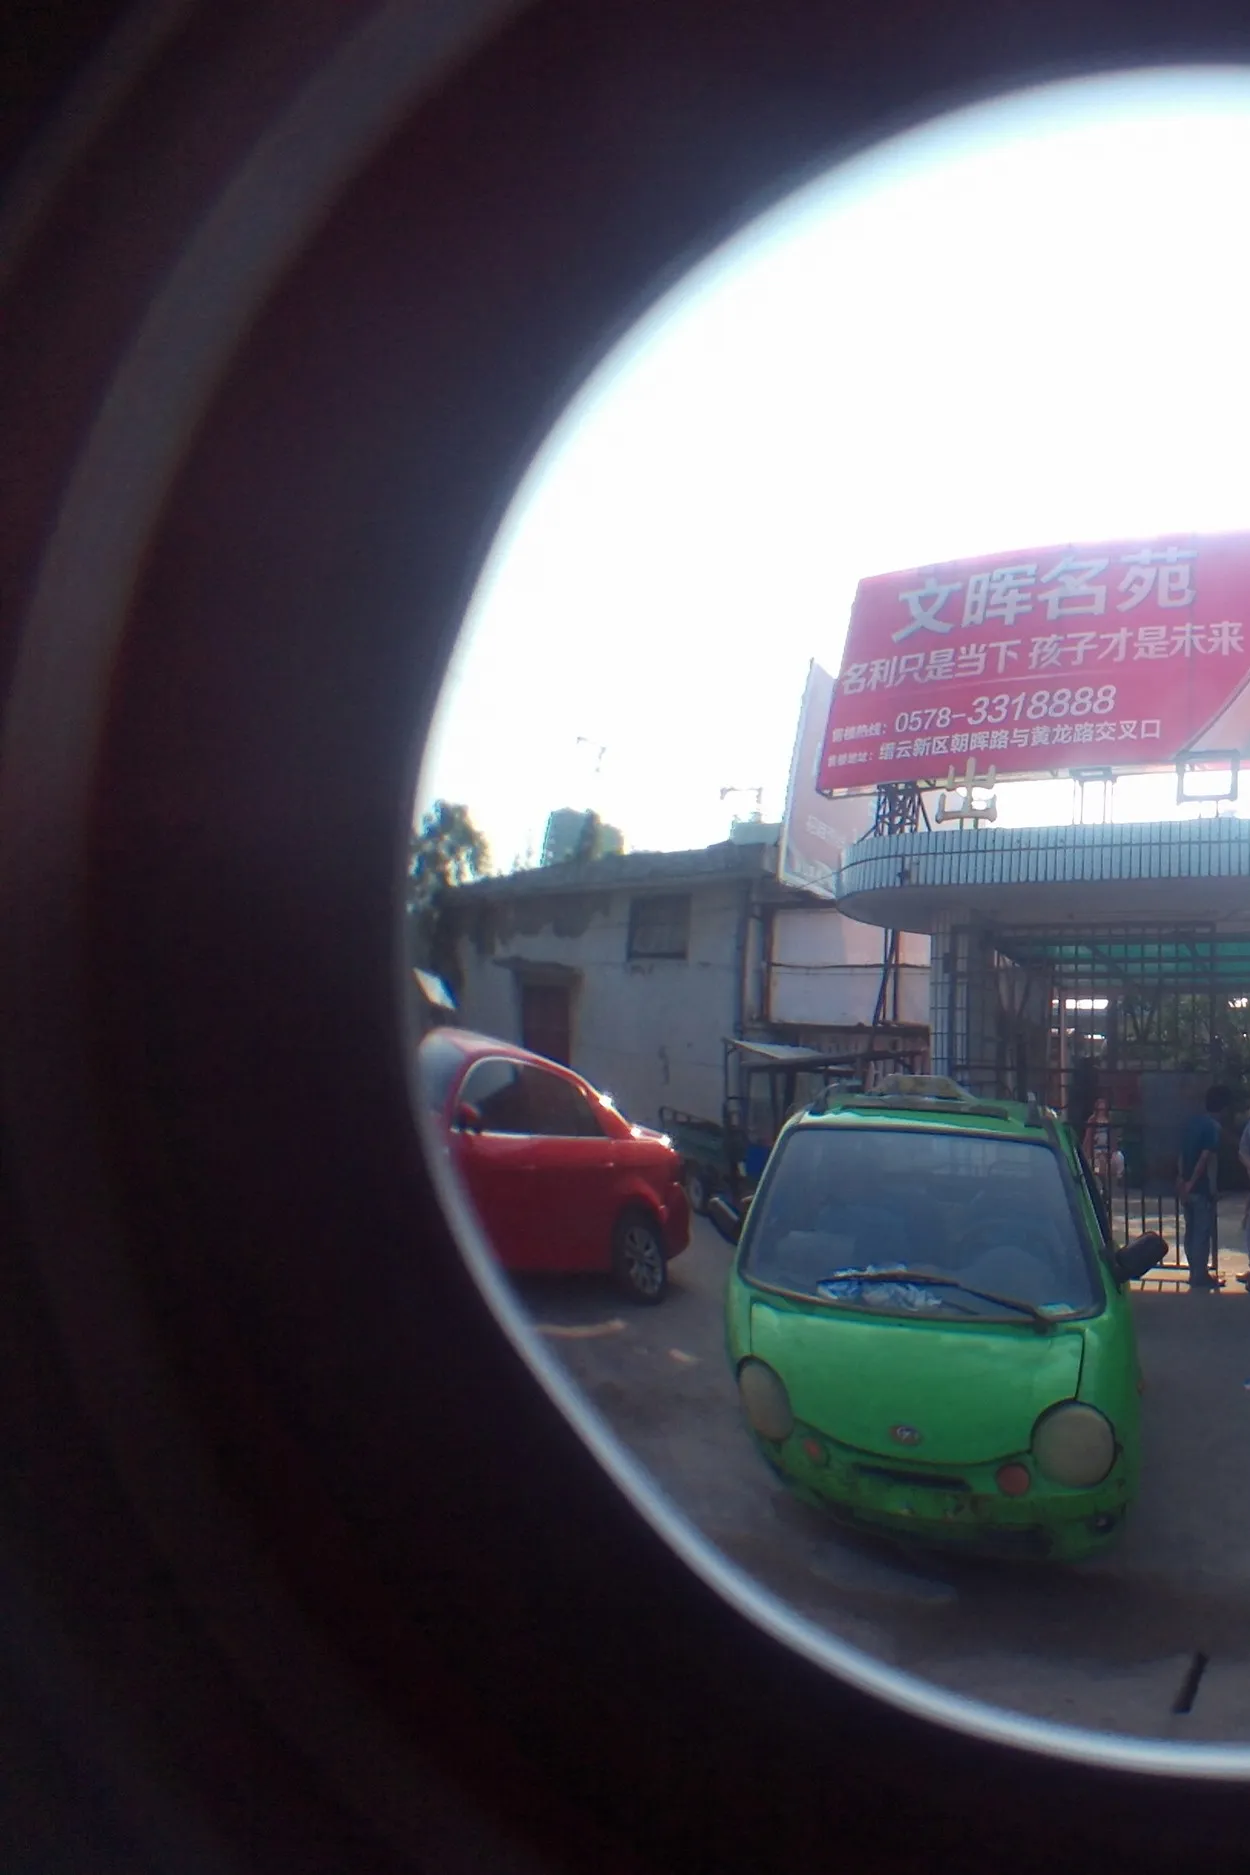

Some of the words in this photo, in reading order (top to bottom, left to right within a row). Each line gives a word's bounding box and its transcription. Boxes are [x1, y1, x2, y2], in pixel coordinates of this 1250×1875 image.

[891, 546, 1198, 643] 文晖名苑
[841, 639, 1022, 695] 名利只是当下
[1028, 621, 1245, 670] 孩子才是未来
[895, 684, 1117, 732] 0578-3318888
[878, 719, 1162, 760] 缙云新区朝晖路与黄龙路交叉口
